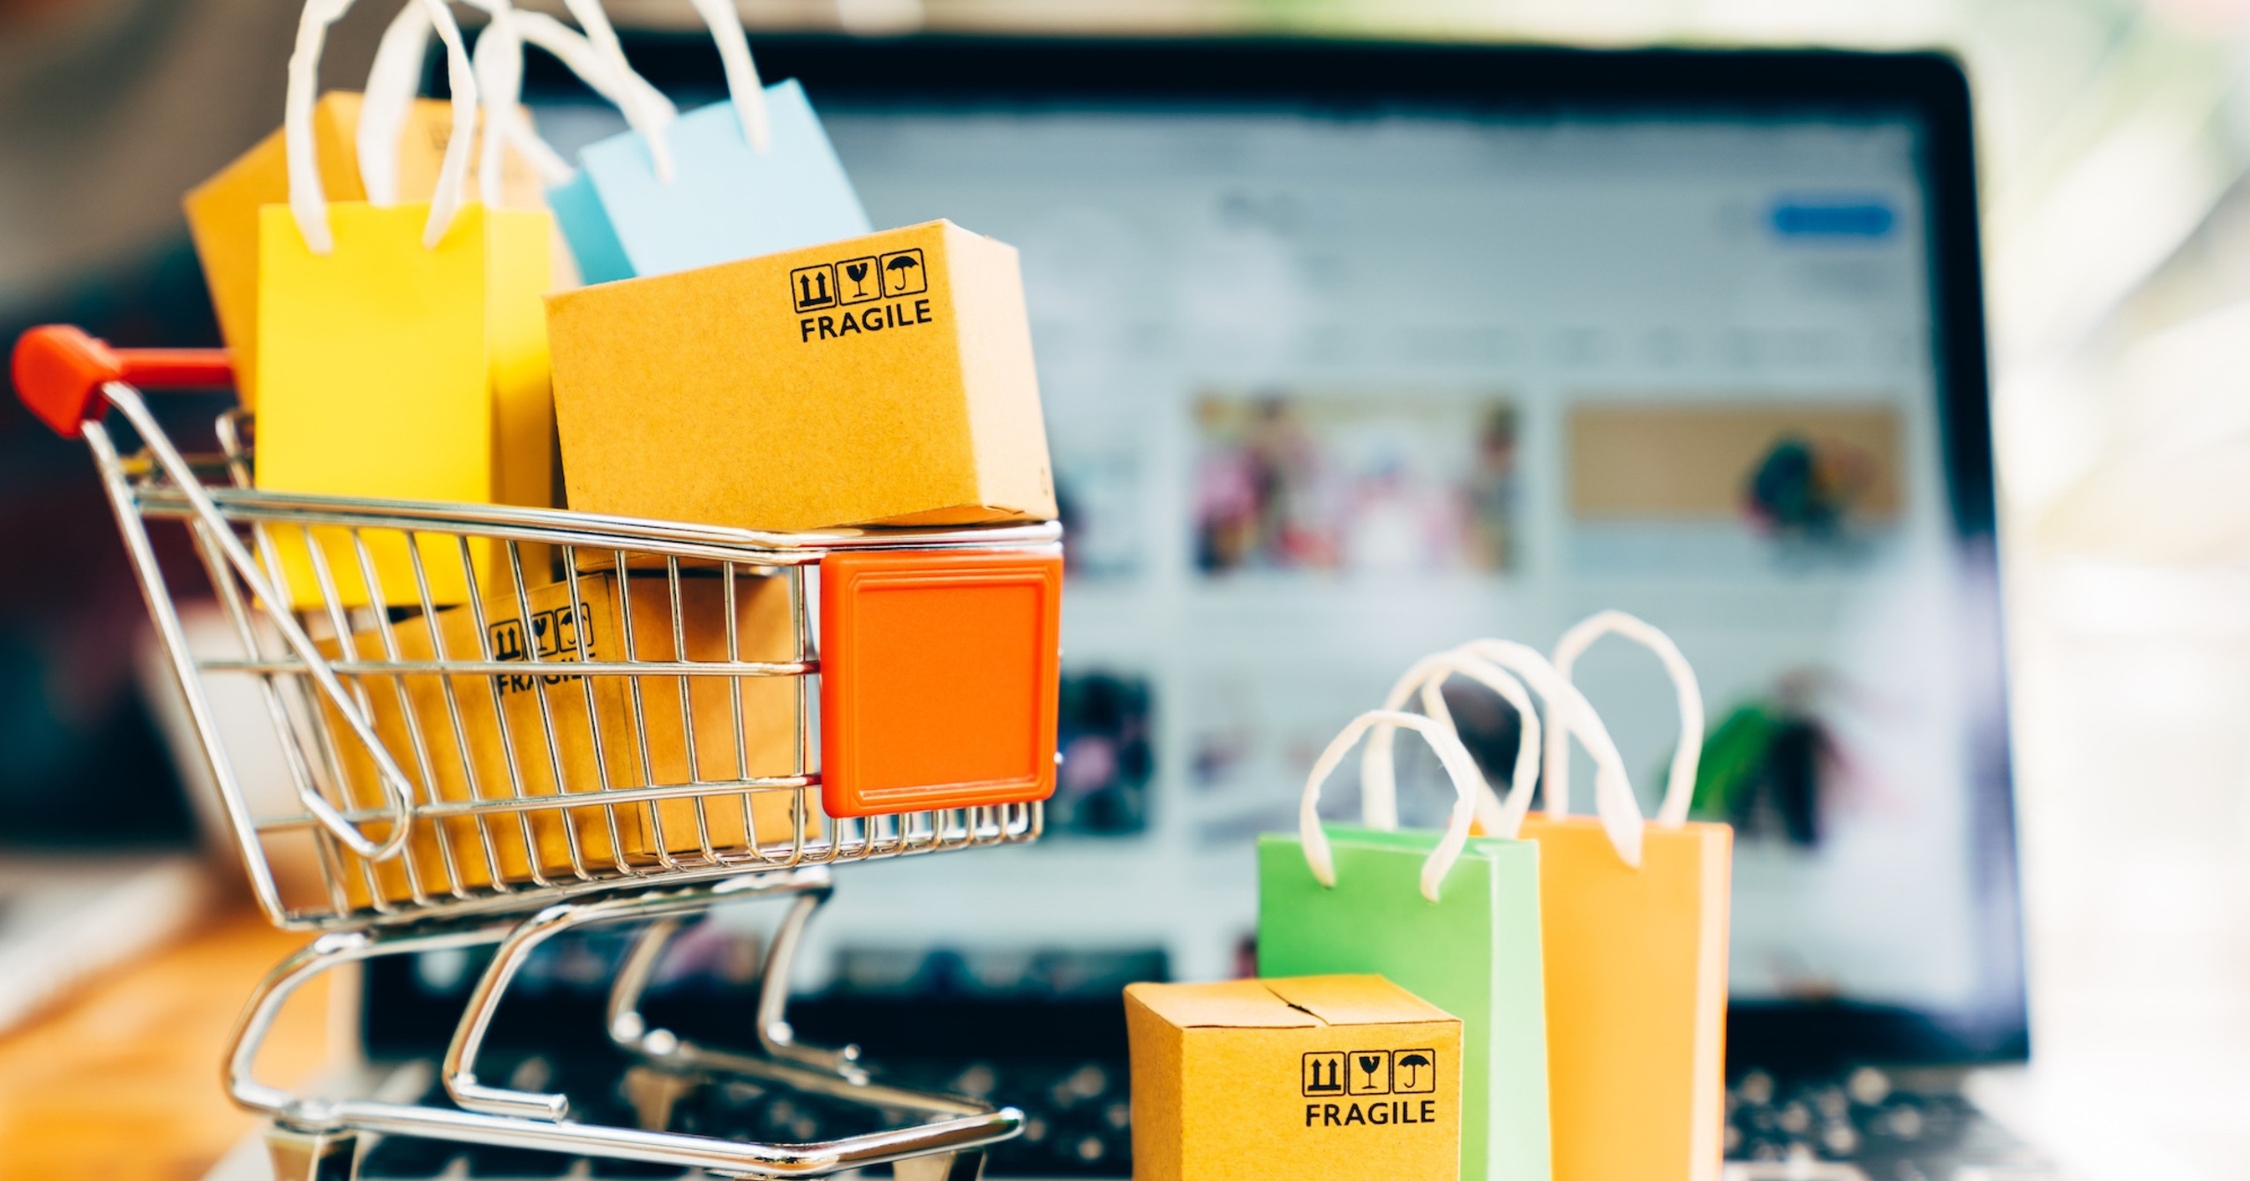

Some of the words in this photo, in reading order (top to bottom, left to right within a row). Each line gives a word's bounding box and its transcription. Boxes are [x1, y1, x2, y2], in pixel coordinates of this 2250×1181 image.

[800, 299, 932, 343] FRAGILE
[495, 653, 596, 696] FRGL
[1306, 1100, 1436, 1127] FRAGILE
